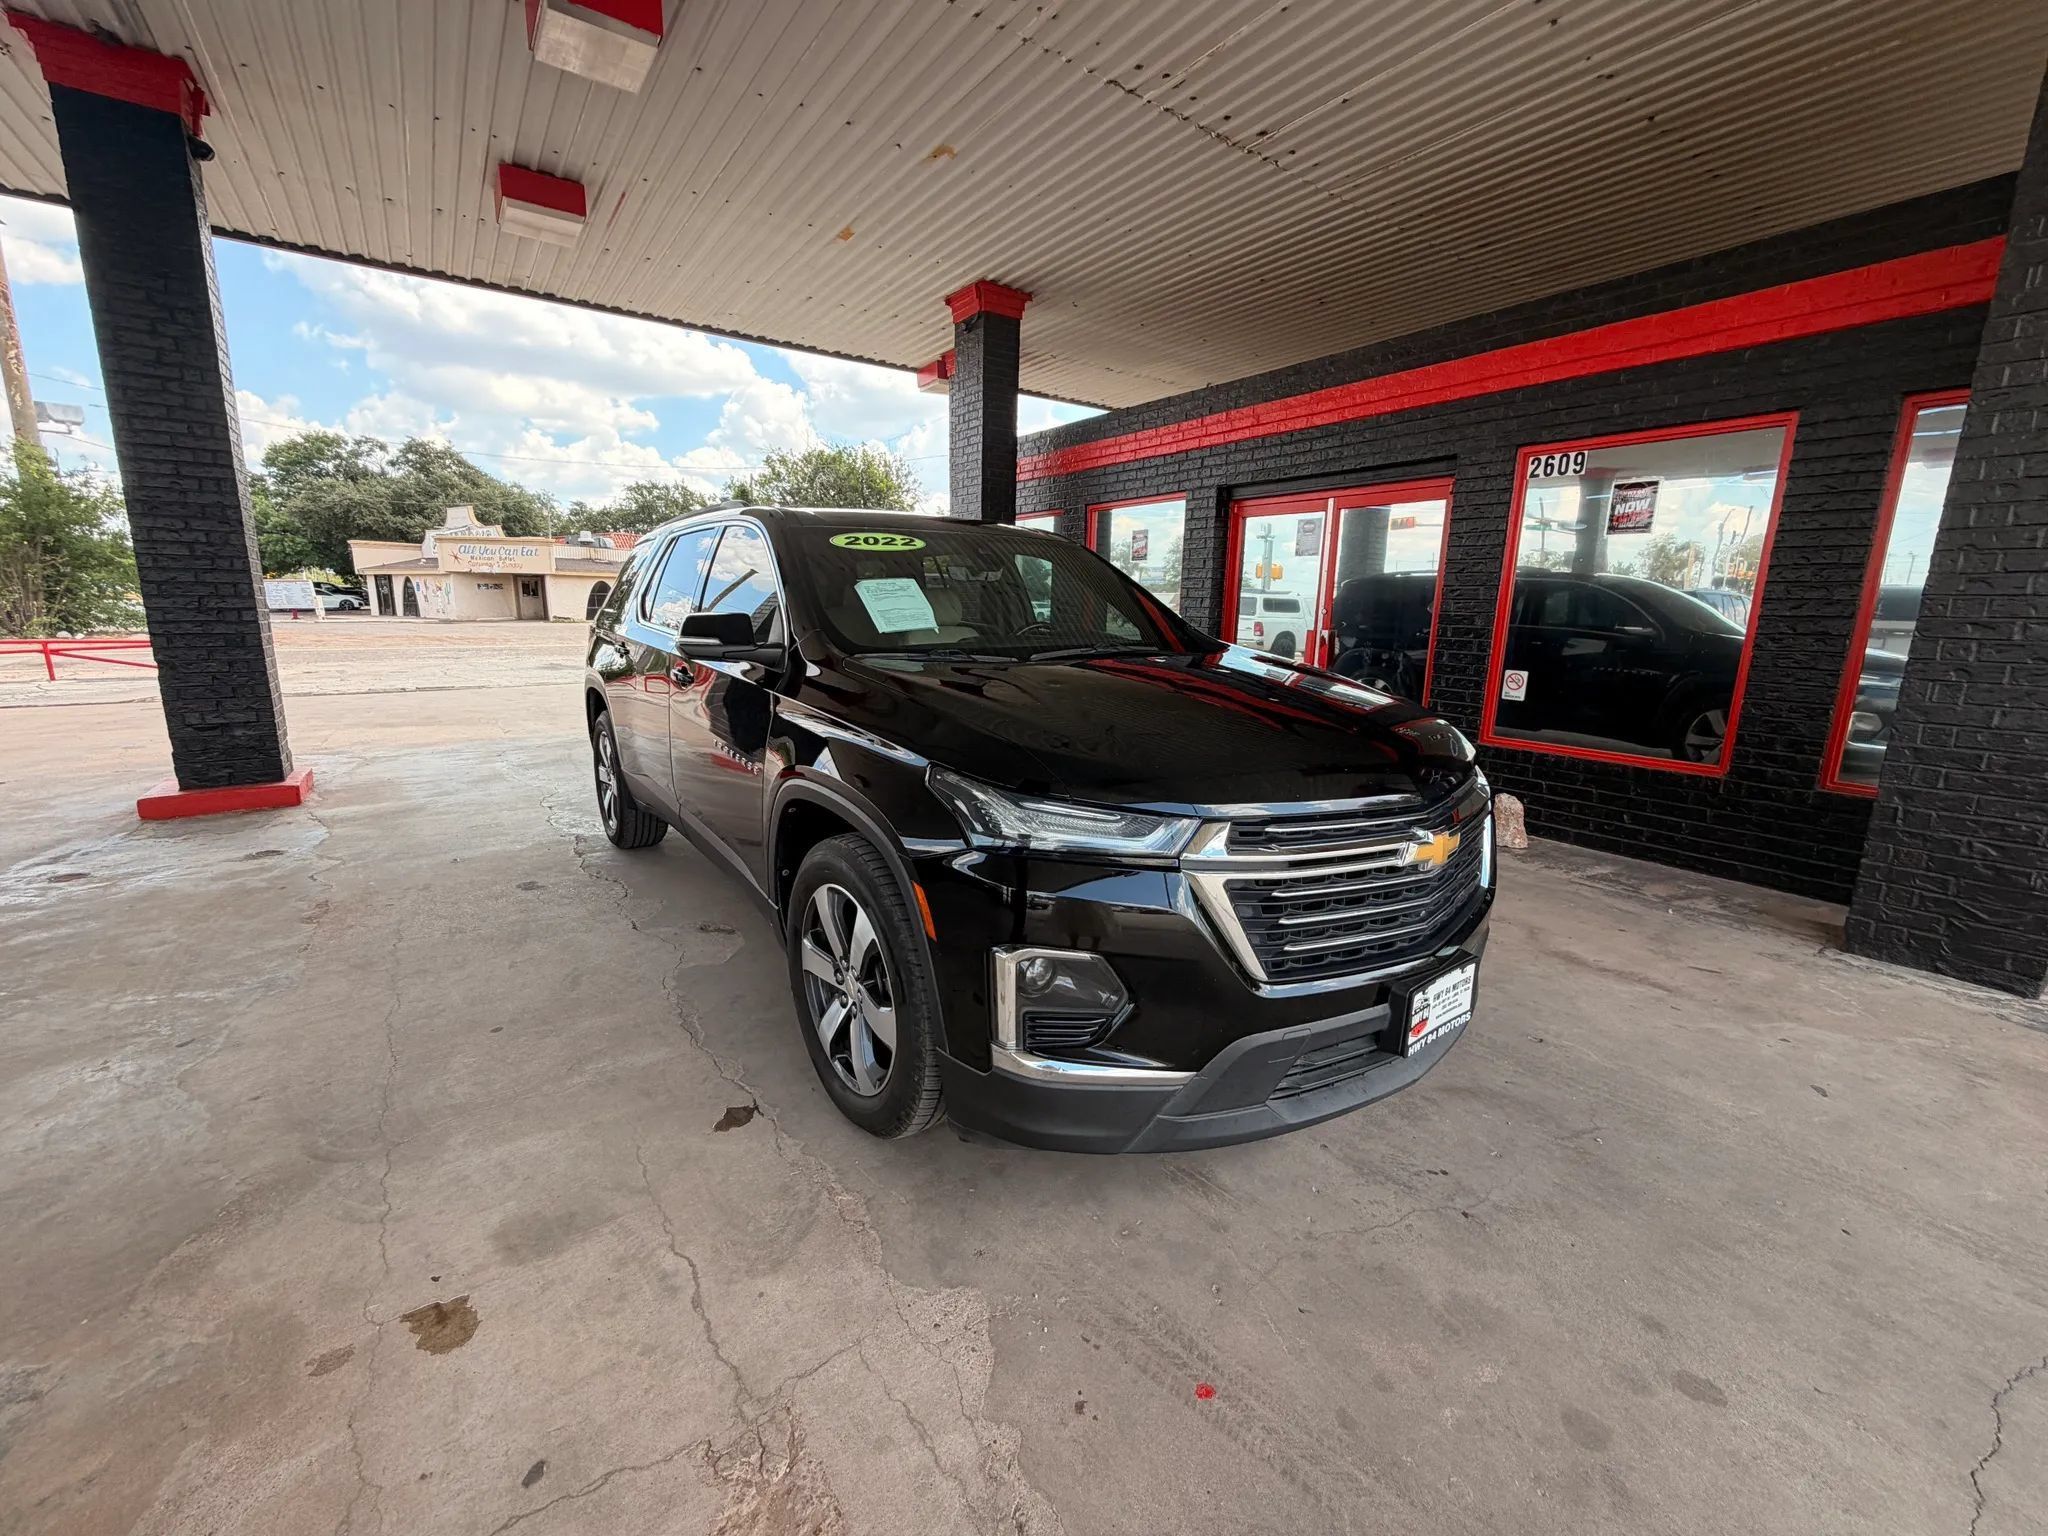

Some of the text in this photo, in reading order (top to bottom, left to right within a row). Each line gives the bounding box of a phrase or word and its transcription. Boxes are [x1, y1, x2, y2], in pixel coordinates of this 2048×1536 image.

[1529, 452, 1586, 478] 2609
[1614, 498, 1651, 515] NOW
[479, 545, 497, 556] You
[498, 545, 519, 557] Can
[521, 546, 539, 557] Eat
[844, 536, 917, 547] 2022
[1433, 990, 1444, 1002] HWY
[1445, 986, 1451, 996] 84
[1452, 976, 1471, 991] MOTORS
[1408, 1012, 1471, 1056] HWY 84 MOTORS
